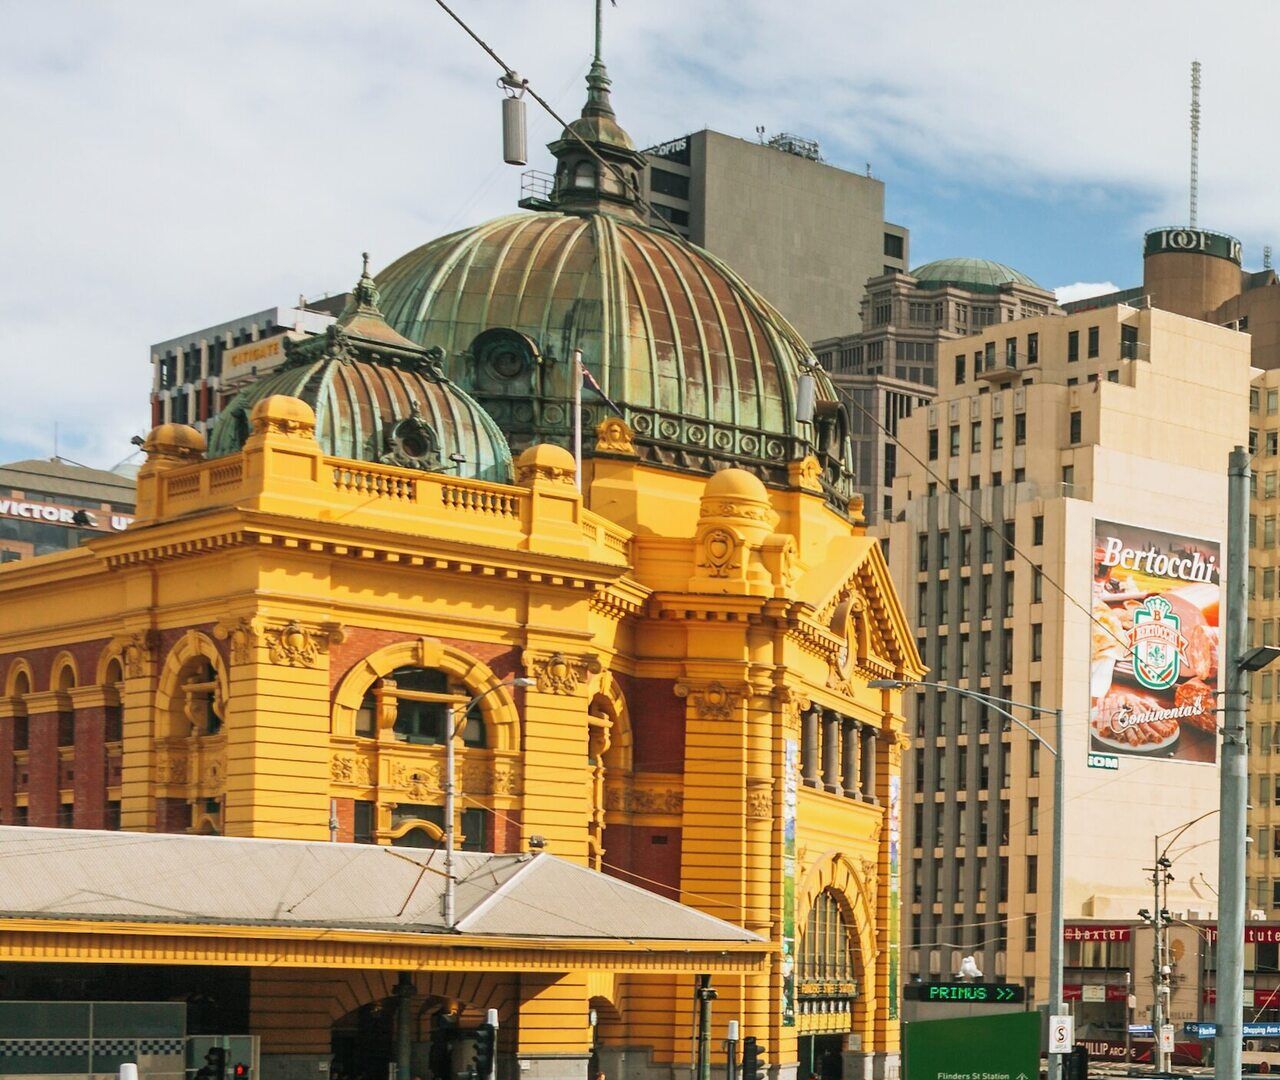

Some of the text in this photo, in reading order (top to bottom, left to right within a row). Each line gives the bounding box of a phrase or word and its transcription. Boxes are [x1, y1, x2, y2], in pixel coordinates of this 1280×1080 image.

[659, 139, 687, 155] OPTUS
[1161, 230, 1212, 250] IOOF
[0, 500, 98, 528] VICTOR
[1103, 536, 1216, 584] Bertocchi
[1136, 626, 1177, 644] BERTOCCHI
[1075, 928, 1124, 941] baxter
[929, 986, 987, 1000] PRIMUS
[1243, 1026, 1265, 1037] Shopping
[1108, 1047, 1137, 1057] ARCAE
[937, 1072, 1010, 1080] Flinders St Station
